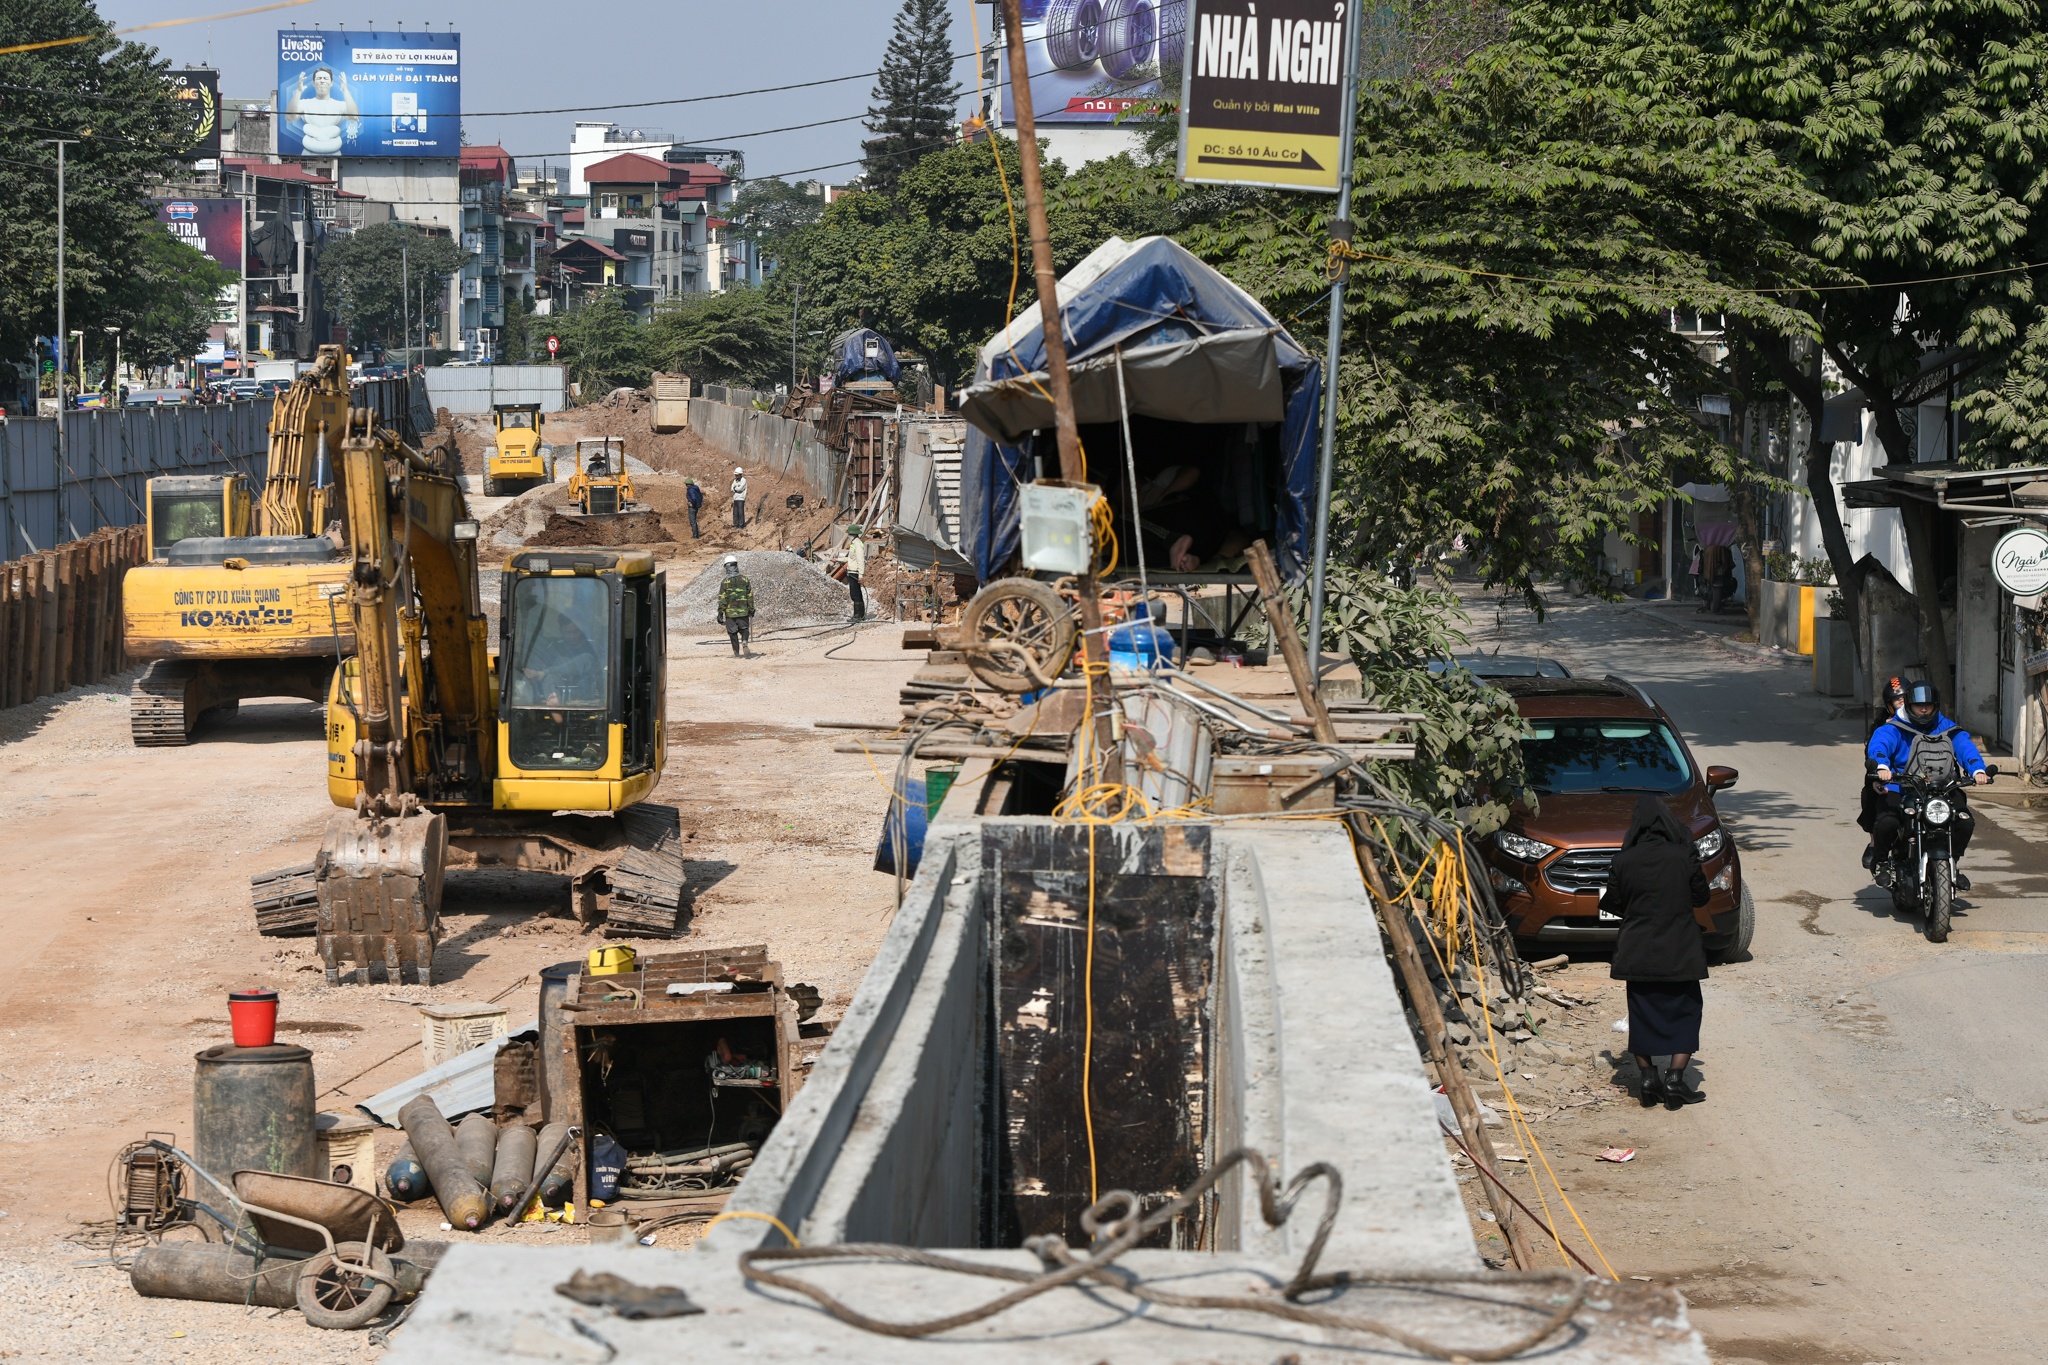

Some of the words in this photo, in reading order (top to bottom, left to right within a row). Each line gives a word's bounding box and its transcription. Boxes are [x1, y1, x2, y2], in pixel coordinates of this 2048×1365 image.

[281, 38, 323, 52] LiveSpo
[1197, 2, 1259, 80] NHÀ
[1267, 2, 1345, 85] NGHỈ
[281, 51, 323, 61] COLON
[409, 54, 422, 62] LỢI
[379, 73, 403, 82] VIÊM
[405, 75, 423, 84] ĐẠI
[425, 73, 458, 83] TRÀNG
[1213, 98, 1241, 110] Quản
[1243, 101, 1253, 113] lý
[1254, 100, 1270, 112] bởi
[1273, 103, 1294, 114] Mai
[1296, 104, 1320, 115] Villa
[1203, 144, 1225, 155] ĐC:
[1228, 144, 1243, 155] Số
[1247, 147, 1260, 157] 10
[1262, 146, 1278, 158] Âu
[1281, 149, 1299, 159] Cơ
[174, 588, 194, 606] CÔNG
[195, 590, 204, 605] TY
[231, 586, 251, 604] XUÂN
[254, 588, 281, 603] QUANG
[181, 604, 293, 628] KOMATSU
